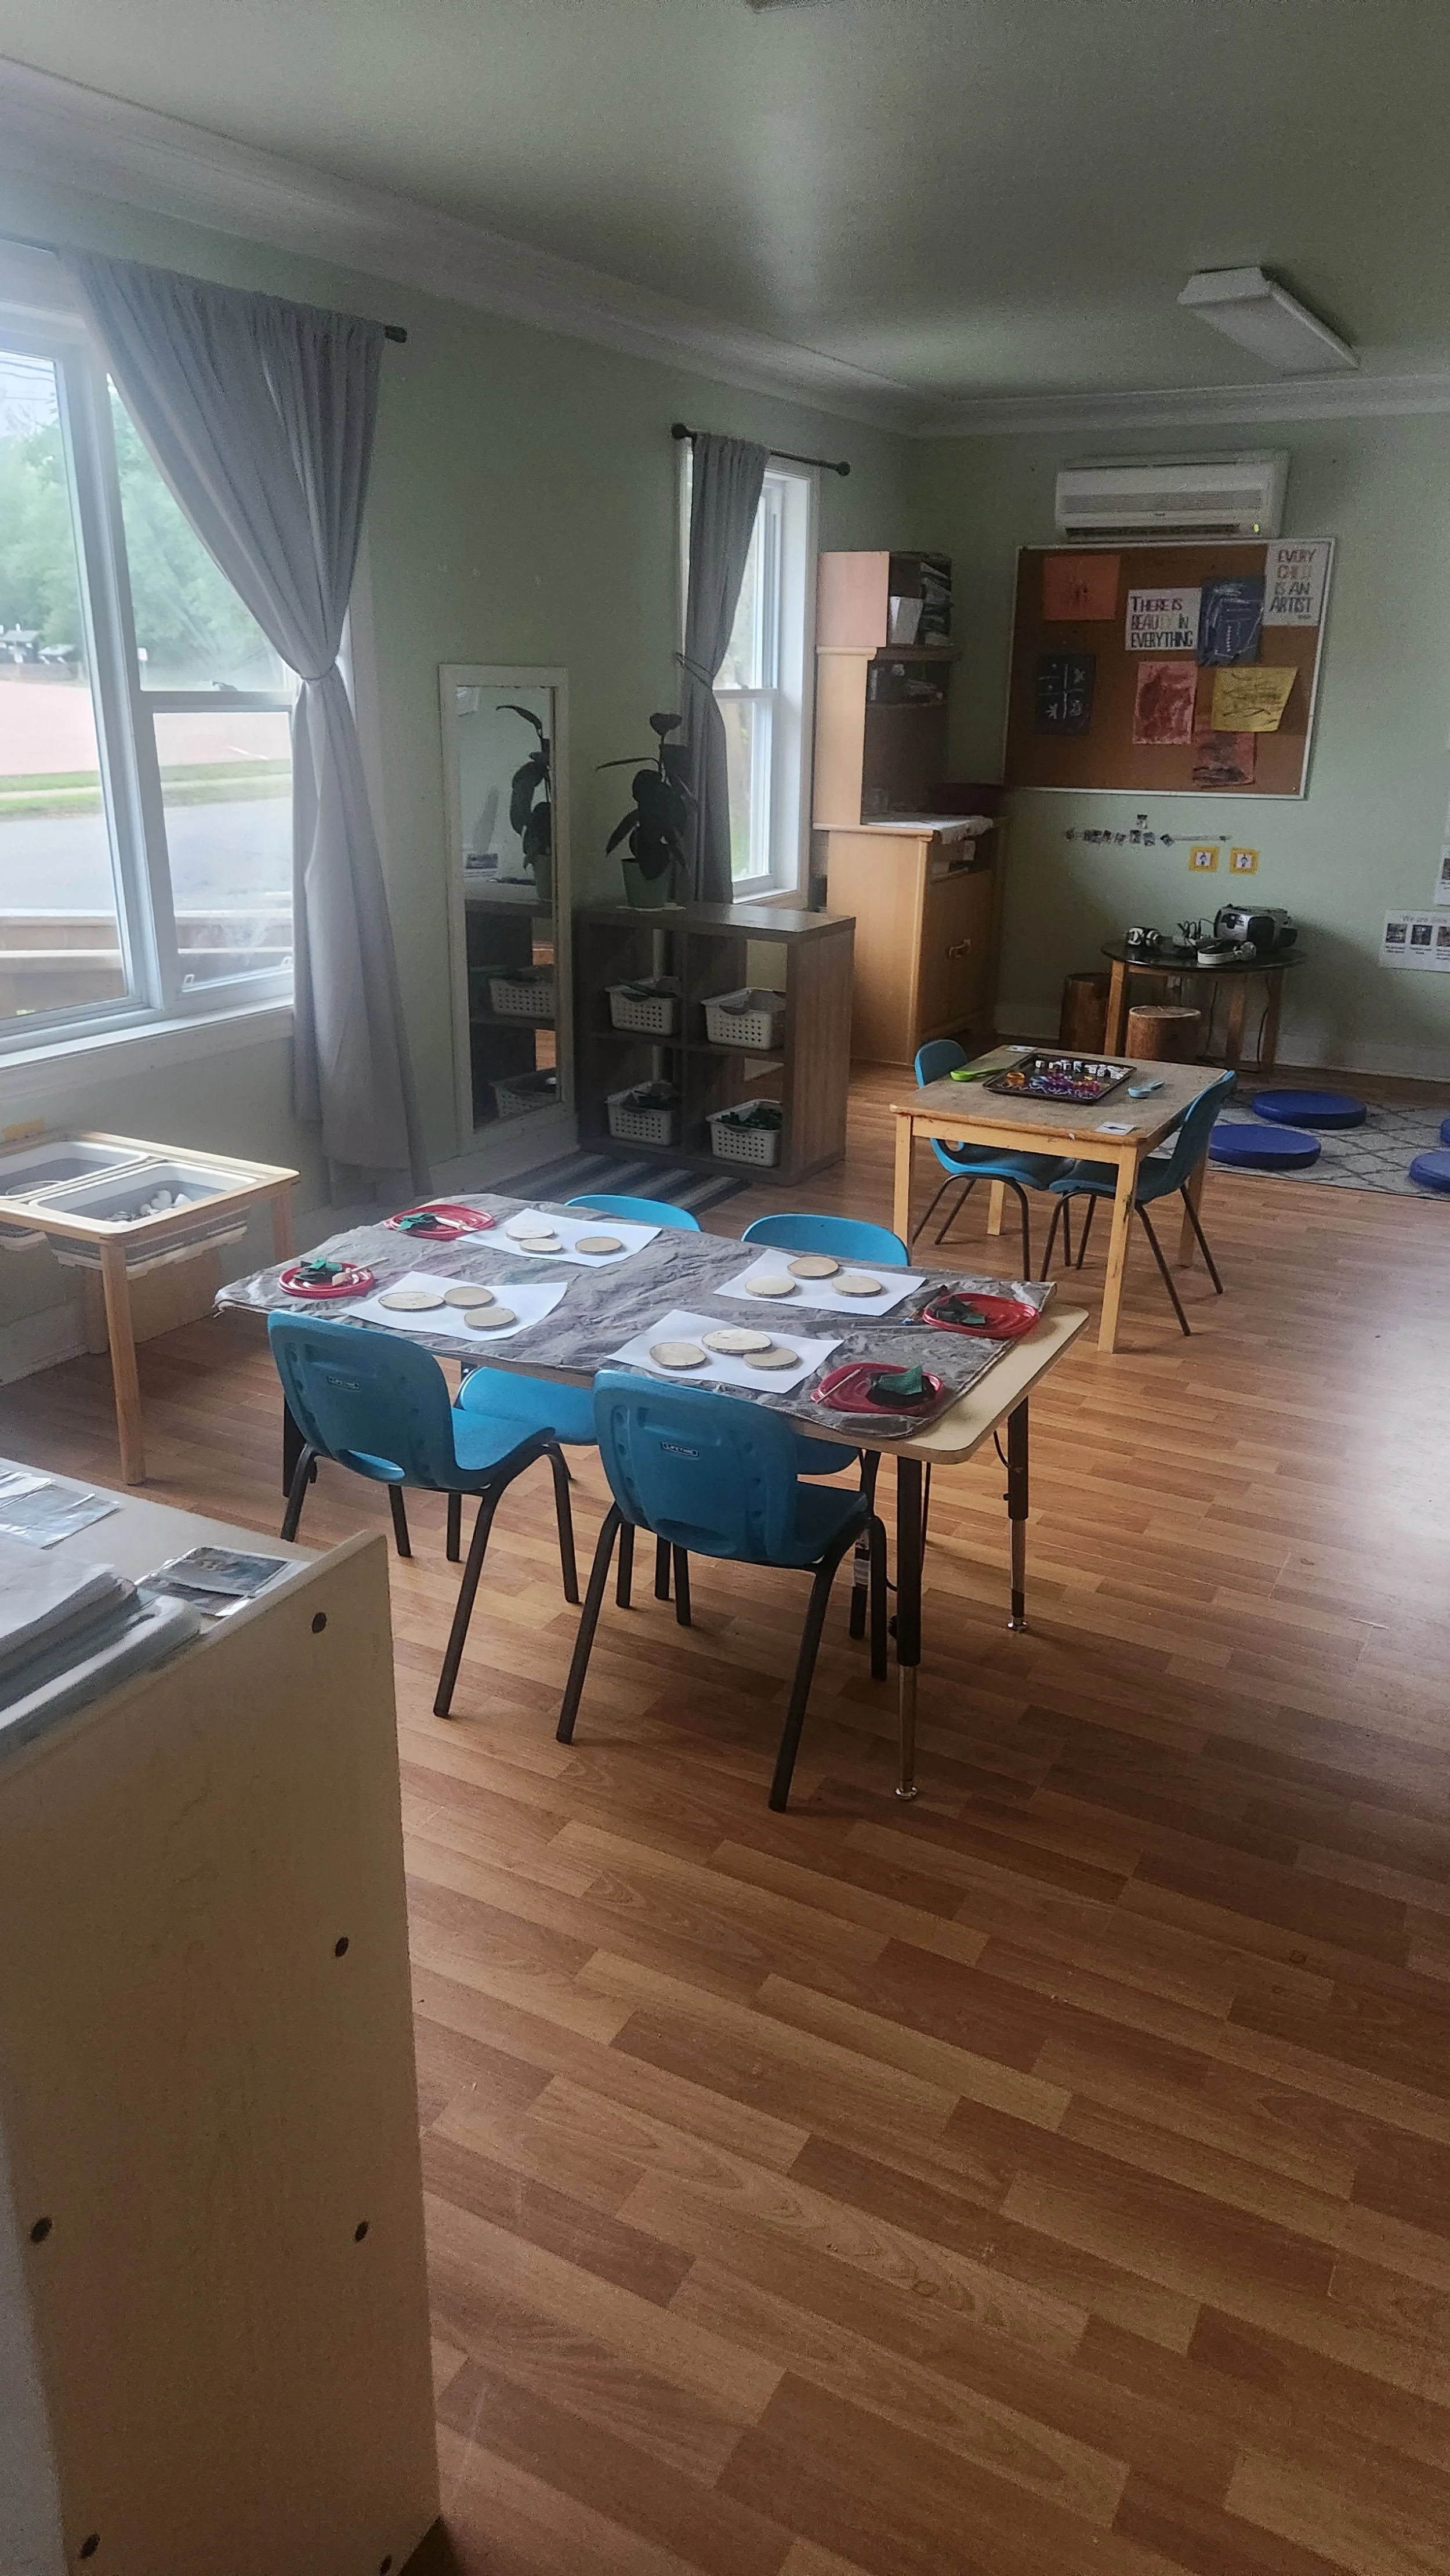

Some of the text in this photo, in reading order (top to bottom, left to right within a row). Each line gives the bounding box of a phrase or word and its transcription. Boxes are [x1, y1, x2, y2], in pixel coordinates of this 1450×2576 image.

[1278, 549, 1317, 564] EVERY
[1289, 582, 1310, 595] AN
[1130, 596, 1183, 612] THERE IS
[1269, 596, 1314, 613] ARTIST
[1131, 614, 1173, 630] BEAU
[1131, 630, 1193, 648] EVERYTHING
